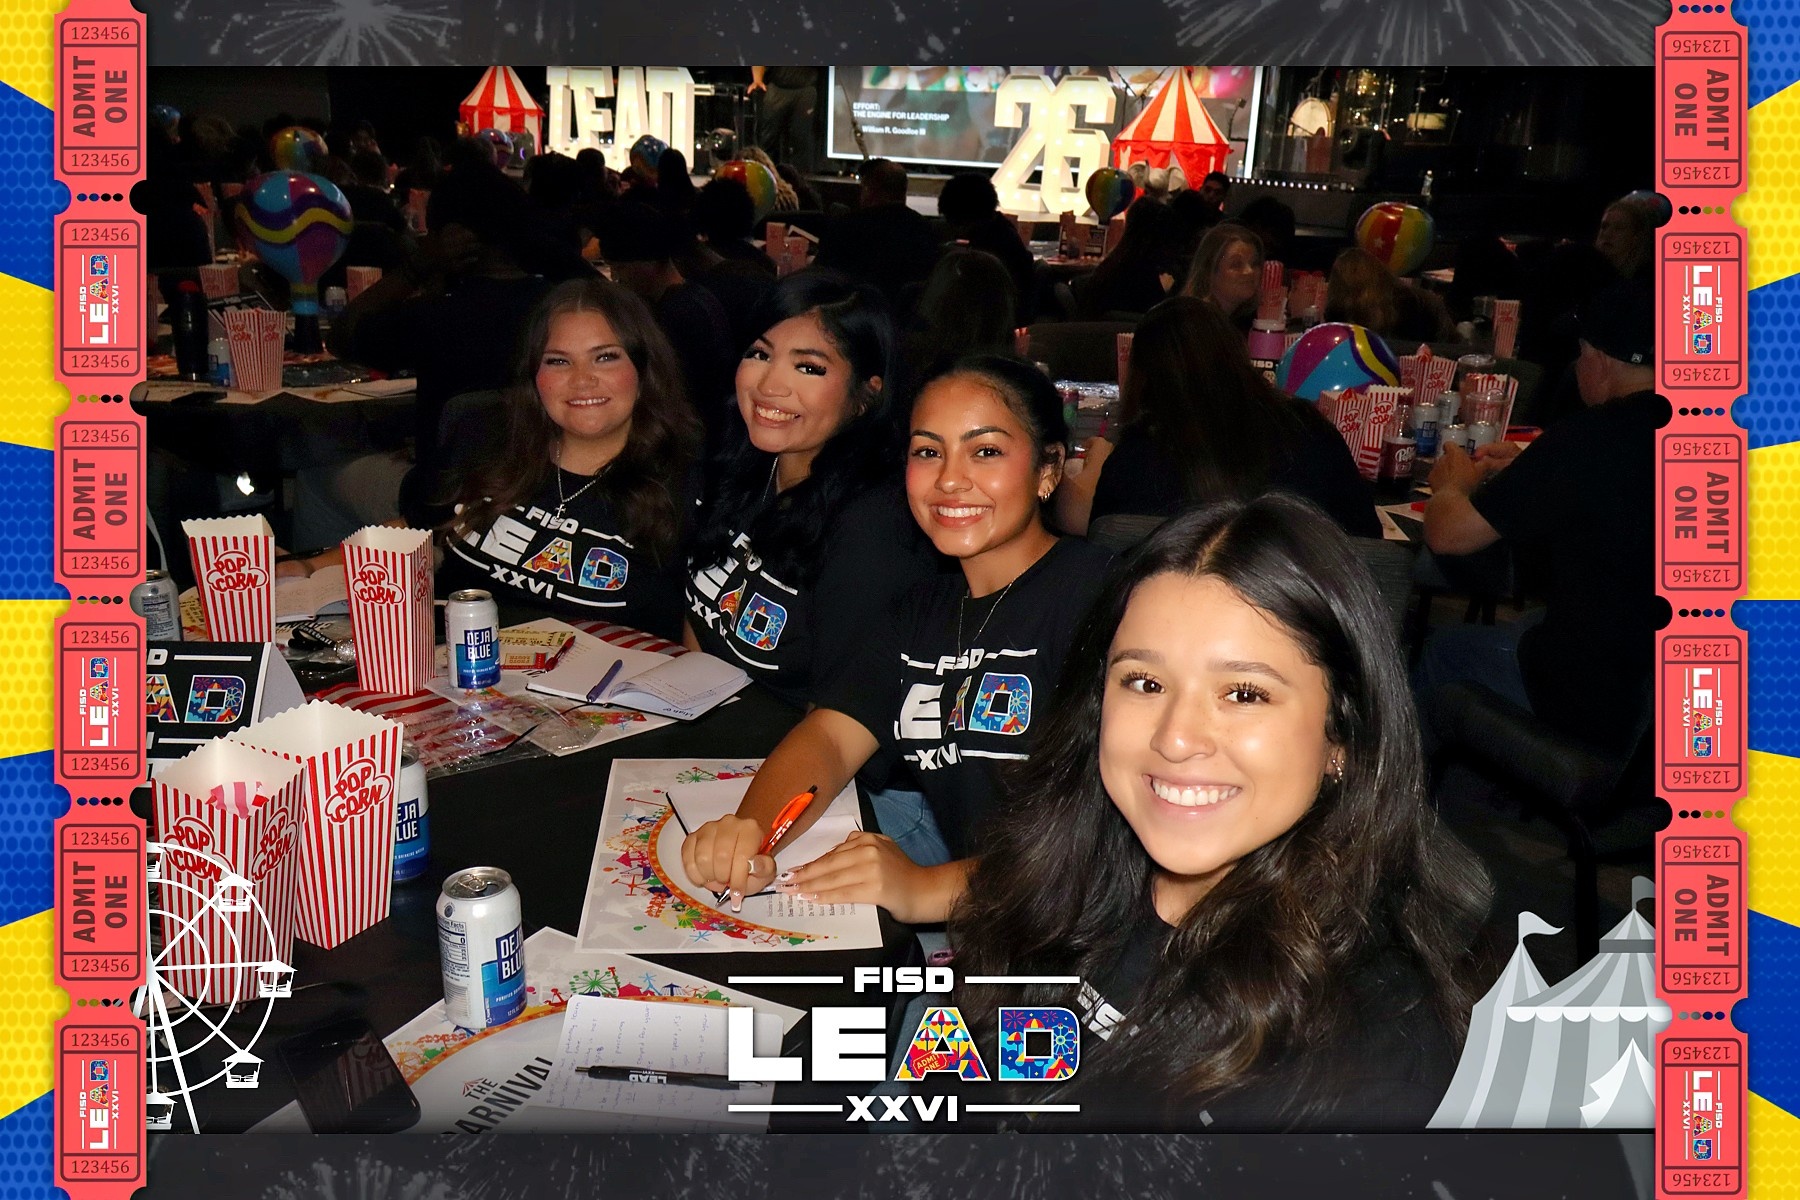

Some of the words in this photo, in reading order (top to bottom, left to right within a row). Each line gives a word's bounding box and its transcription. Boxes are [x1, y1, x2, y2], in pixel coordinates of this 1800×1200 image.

[853, 102, 880, 110] EFFORT:
[853, 110, 866, 118] THE
[867, 111, 892, 119] ENGINE
[907, 112, 950, 121] LEADERSHIP
[546, 66, 694, 173] LEAD
[991, 75, 1116, 216] 26
[1374, 405, 1391, 416] POP
[526, 506, 579, 535] FISD
[732, 532, 763, 571] FD
[214, 557, 246, 576] POP
[359, 568, 386, 586] POP
[214, 573, 258, 592] CORN
[490, 563, 554, 599] XXVI
[359, 585, 396, 604] CORN
[467, 630, 490, 646] DEJA
[468, 644, 492, 660] BLUE
[936, 649, 985, 675] FSD
[146, 674, 246, 724] AD
[894, 672, 1033, 740] EAD
[335, 766, 372, 799] POP
[334, 784, 383, 823] CORN
[397, 803, 416, 824] EJA
[173, 825, 210, 850] POP
[260, 816, 285, 853] POP
[396, 820, 418, 842] LUE
[252, 832, 292, 881] CORN
[1077, 980, 1126, 1041] FIS
[464, 1078, 498, 1100] THE
[629, 1074, 667, 1084] LEAD
